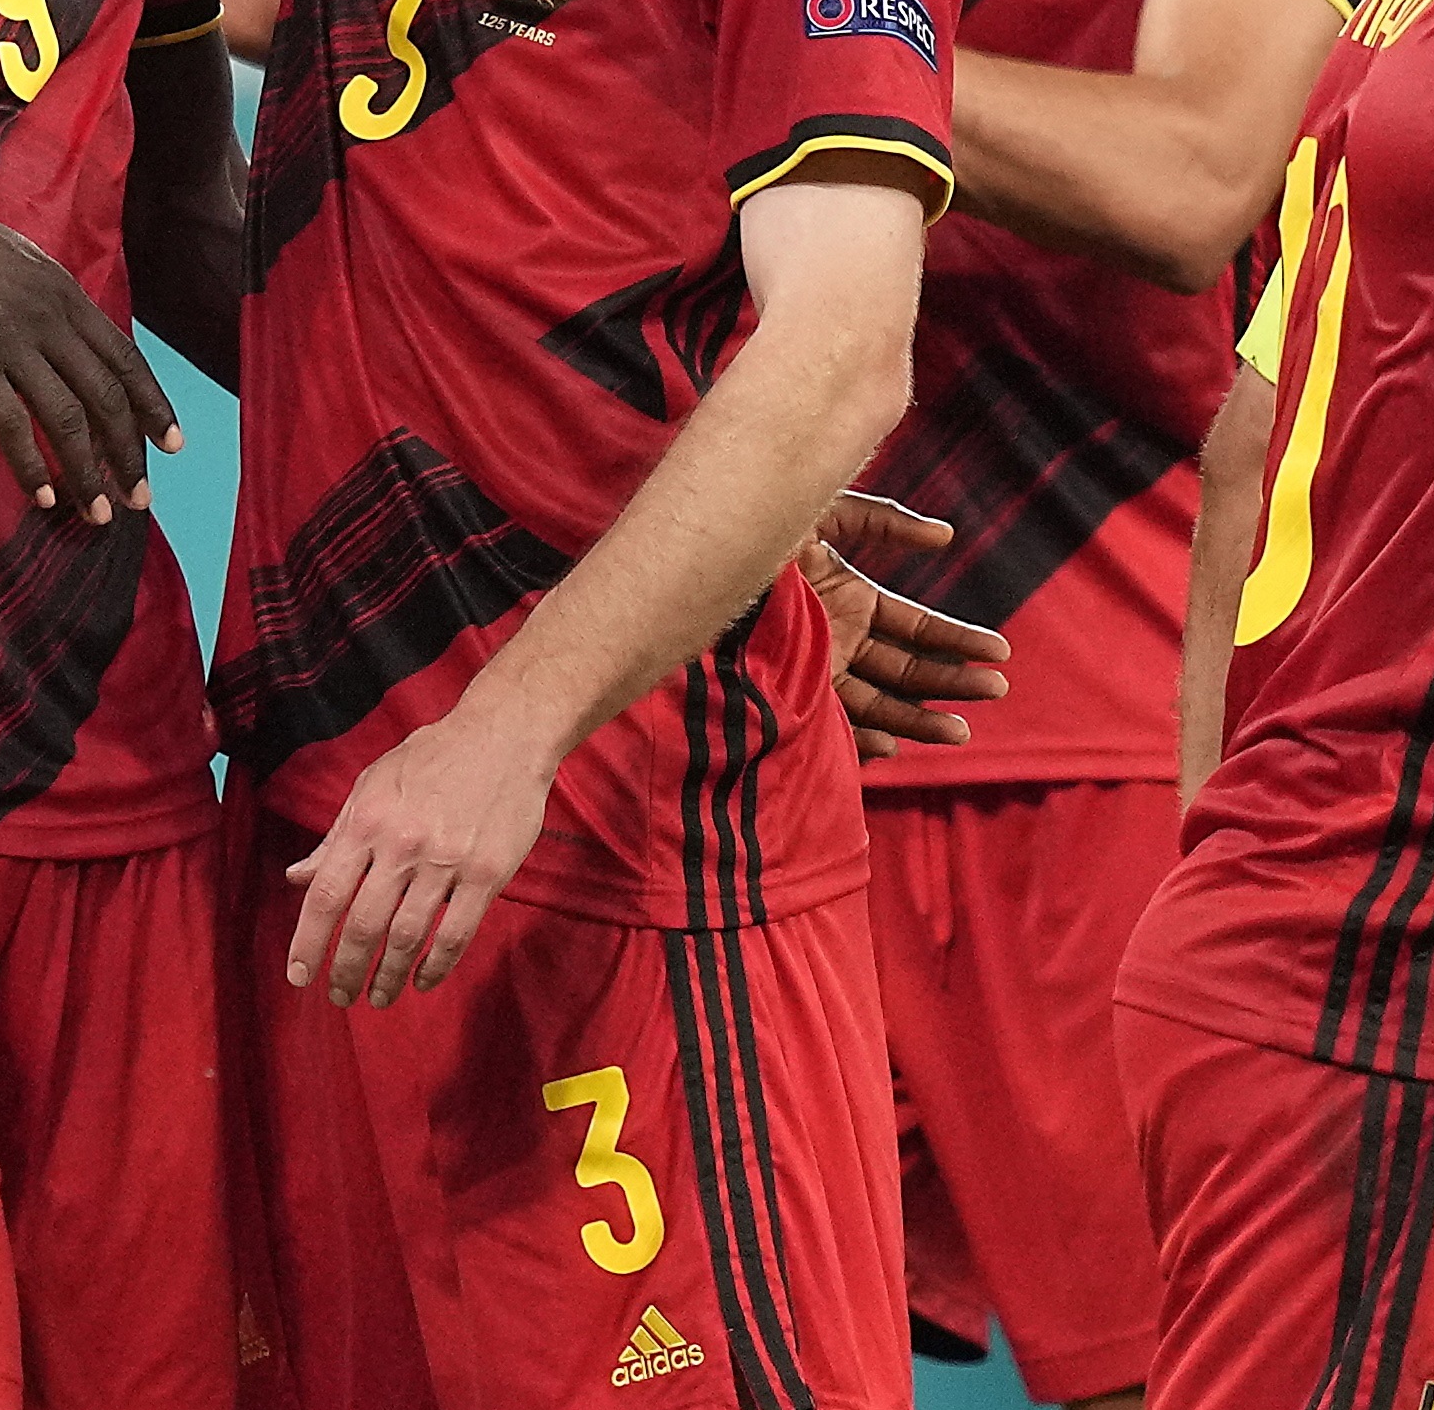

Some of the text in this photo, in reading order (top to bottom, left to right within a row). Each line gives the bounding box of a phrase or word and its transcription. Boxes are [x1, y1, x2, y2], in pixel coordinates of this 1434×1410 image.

[478, 12, 557, 47] 125 YEARS
[541, 1064, 665, 1276] 3
[611, 1343, 706, 1388] adidas
